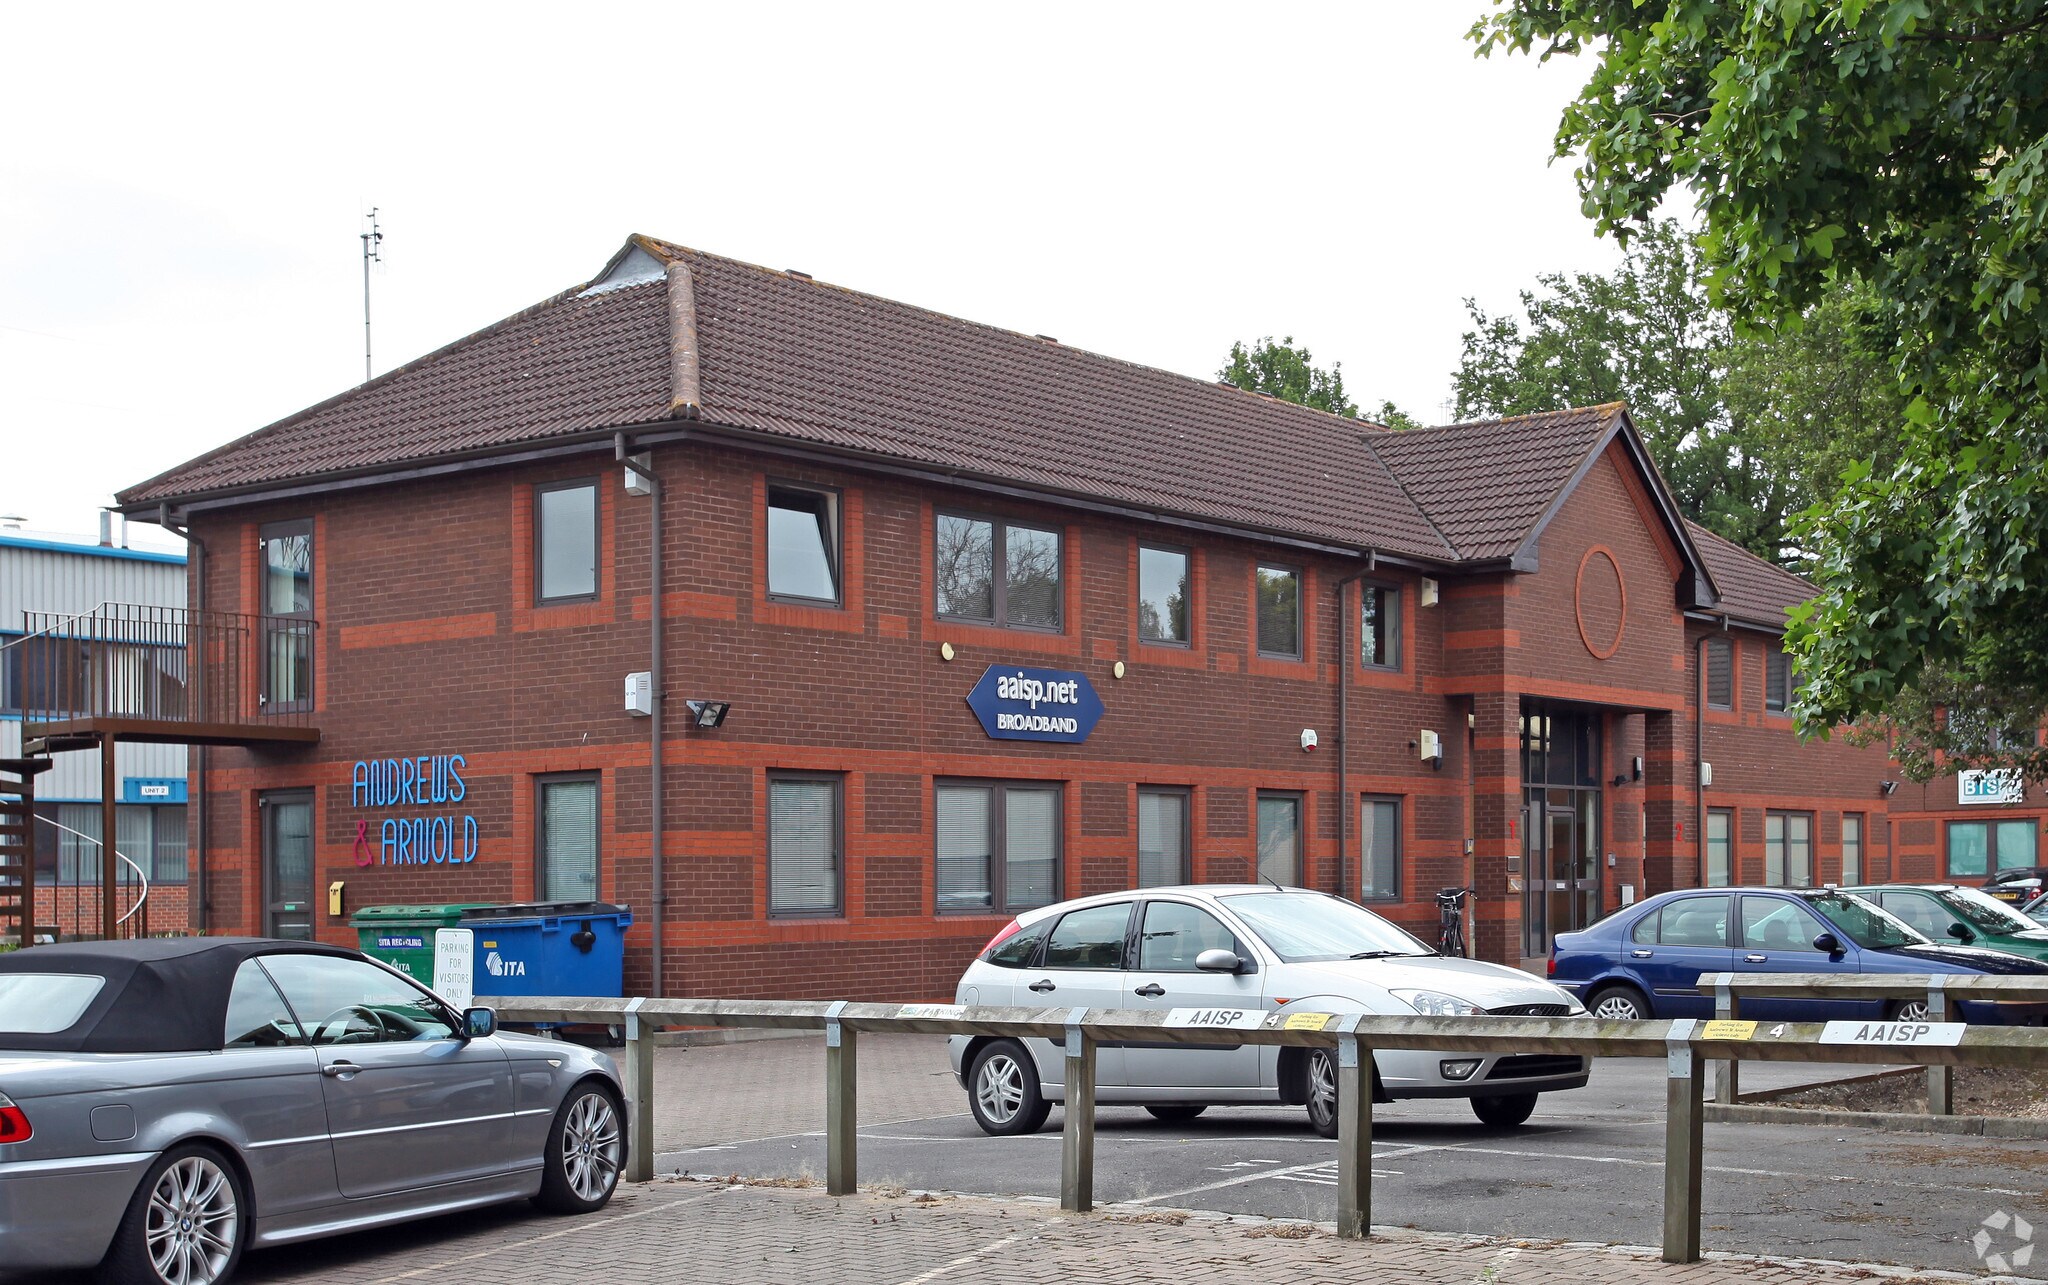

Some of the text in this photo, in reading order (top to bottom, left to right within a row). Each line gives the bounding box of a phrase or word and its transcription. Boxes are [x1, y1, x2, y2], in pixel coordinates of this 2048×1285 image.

[997, 671, 1078, 710] aaisp.net
[997, 713, 1078, 733] BROADBAND
[353, 754, 466, 807] ANDREWS
[1964, 778, 1998, 795] BTS
[1675, 822, 1684, 842] 2
[353, 815, 479, 867] & ARNOLD
[378, 938, 391, 947] SITA
[440, 943, 469, 954] PARKING
[449, 958, 462, 969] FOR
[497, 961, 526, 976] SITA
[439, 973, 469, 984] VISITORS
[446, 988, 463, 999] ONLY
[1187, 1010, 1244, 1026] AAISP
[1266, 1014, 1280, 1027] 4
[1769, 1024, 1786, 1038] 4
[1853, 1024, 1931, 1042] AAISP
